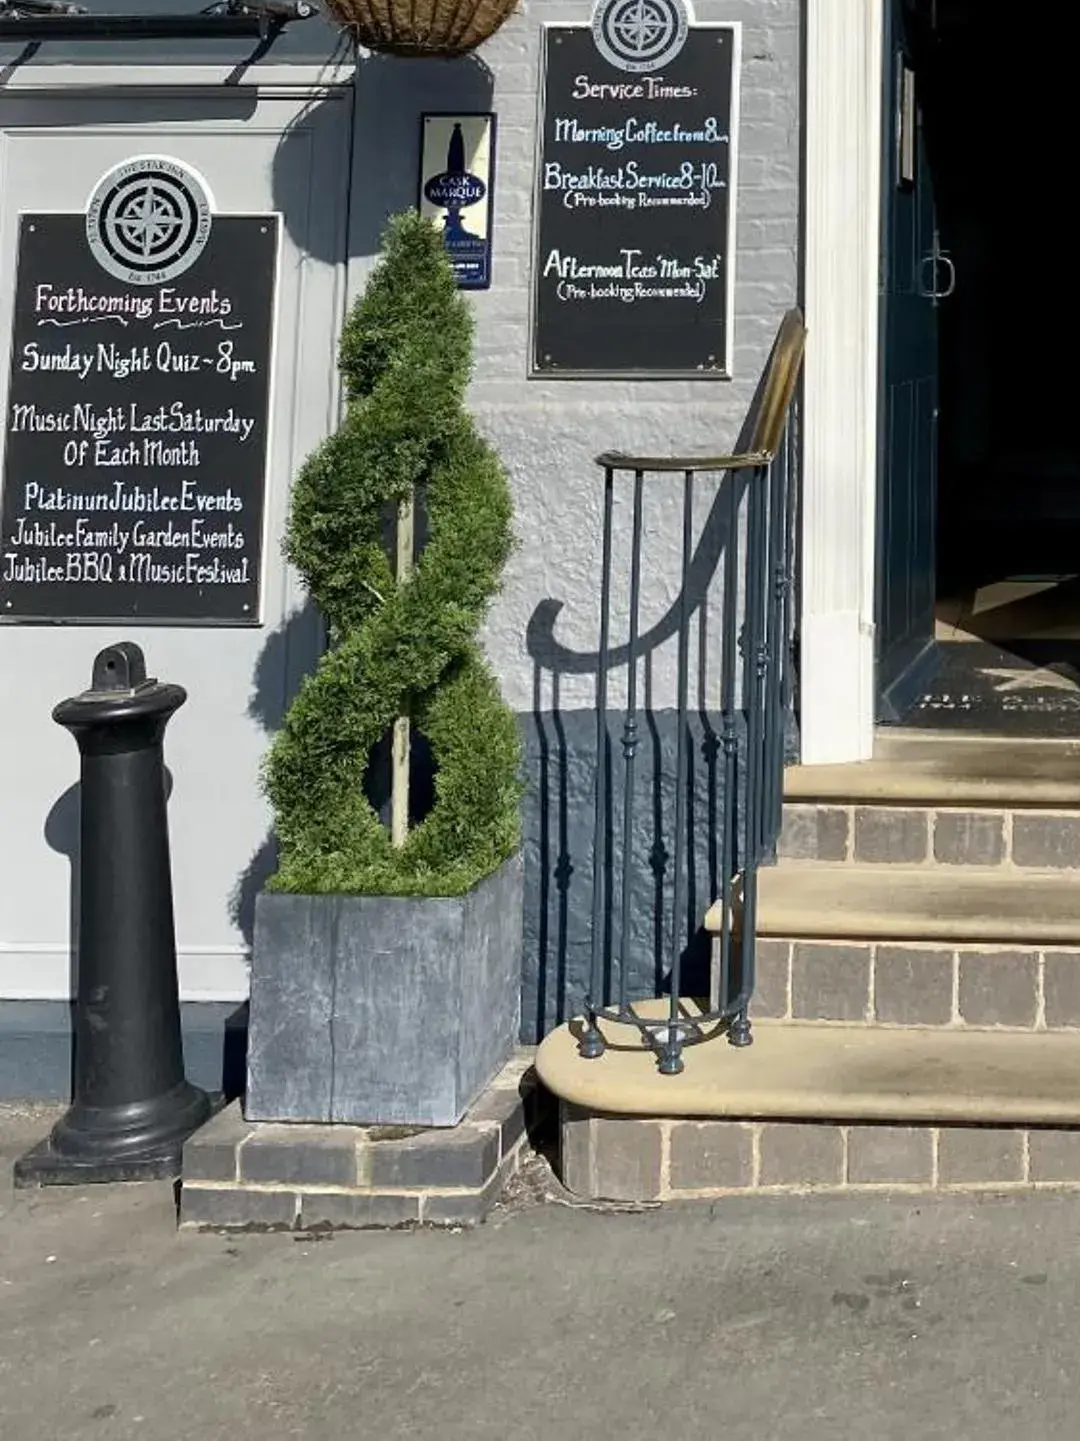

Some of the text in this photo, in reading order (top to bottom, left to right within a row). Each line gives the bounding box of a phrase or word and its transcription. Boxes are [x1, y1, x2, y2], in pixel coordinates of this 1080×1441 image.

[572, 74, 698, 99] Service Times:
[554, 118, 625, 150] Morning
[625, 118, 673, 143] Coffee
[440, 176, 471, 186] CASK
[543, 162, 625, 190] Breakfast
[625, 161, 681, 189] Service
[430, 186, 482, 199] MARQUE
[543, 249, 623, 278] Afternoon
[35, 284, 232, 318] Forthcoming Events
[22, 342, 94, 380] Sunday
[97, 343, 151, 378] Night
[157, 342, 200, 372] Quiz
[11, 401, 255, 441] Music Night Last Saturday
[64, 438, 200, 466] Of Each Month
[109, 480, 180, 511] Jubilee
[180, 480, 243, 511] Events
[11, 518, 245, 554] Jubilee Family Garden Events
[3, 553, 64, 582] Jubilee
[65, 551, 113, 583] BBQ
[129, 553, 185, 583] Music
[185, 553, 250, 584] Festival
